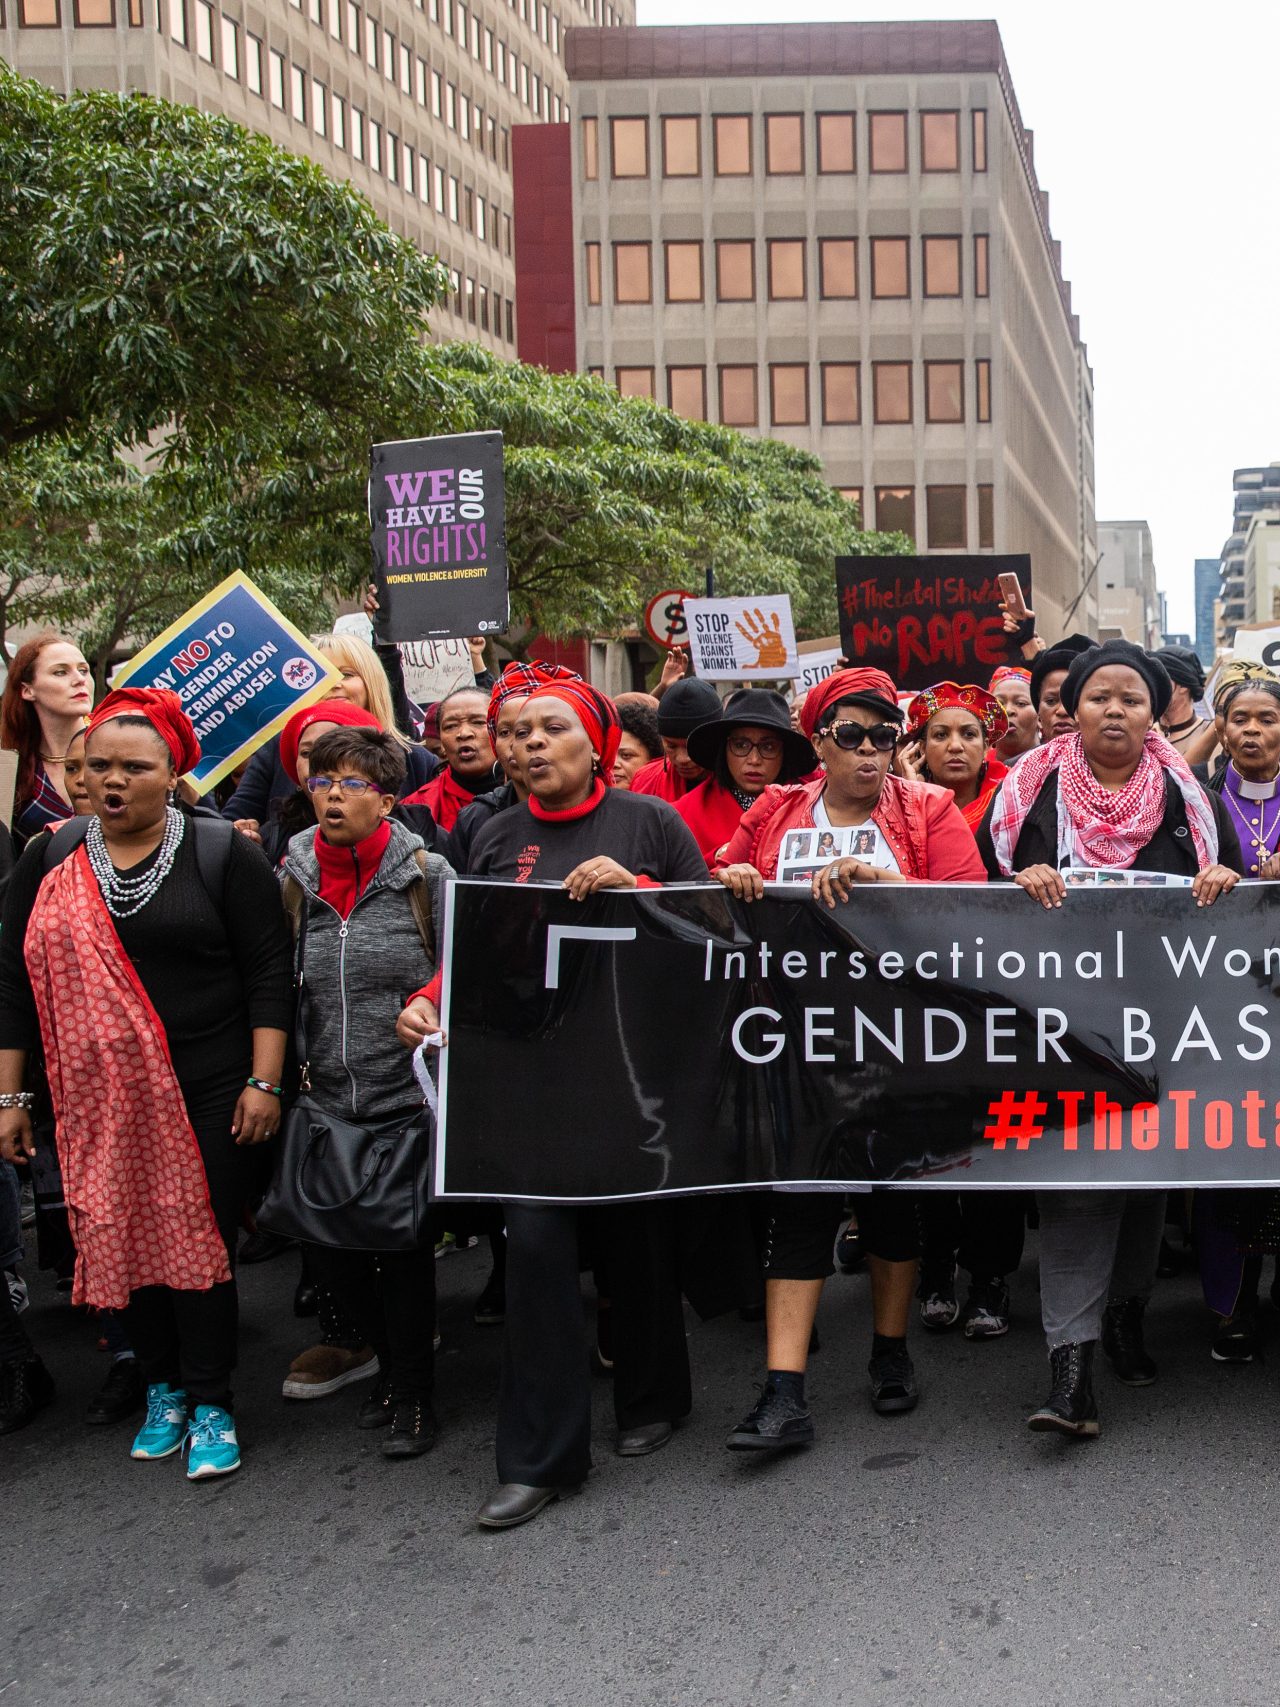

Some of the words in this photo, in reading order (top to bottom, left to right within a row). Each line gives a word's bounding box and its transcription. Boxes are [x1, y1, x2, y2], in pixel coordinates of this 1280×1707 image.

[384, 468, 455, 506] WE
[458, 468, 485, 520] OUR
[385, 503, 456, 528] HAVE
[387, 522, 487, 567] RIGHTS!
[414, 571, 448, 582] VIOLENCE
[453, 567, 488, 580] DIVERSITY
[695, 613, 730, 633] STOP
[696, 633, 733, 645] VIOLENCE
[896, 610, 1009, 679] RAPE
[170, 640, 211, 676] NO
[205, 621, 236, 648] TO
[700, 645, 735, 657] AGAINST
[701, 657, 738, 670] WOMEN
[178, 651, 237, 702] GENDER
[184, 641, 279, 721] CRIMINATION
[193, 711, 226, 741] AND
[224, 667, 277, 715] ABUSE!
[704, 930, 1125, 982] Intersectional
[730, 1005, 1073, 1065] GENDER
